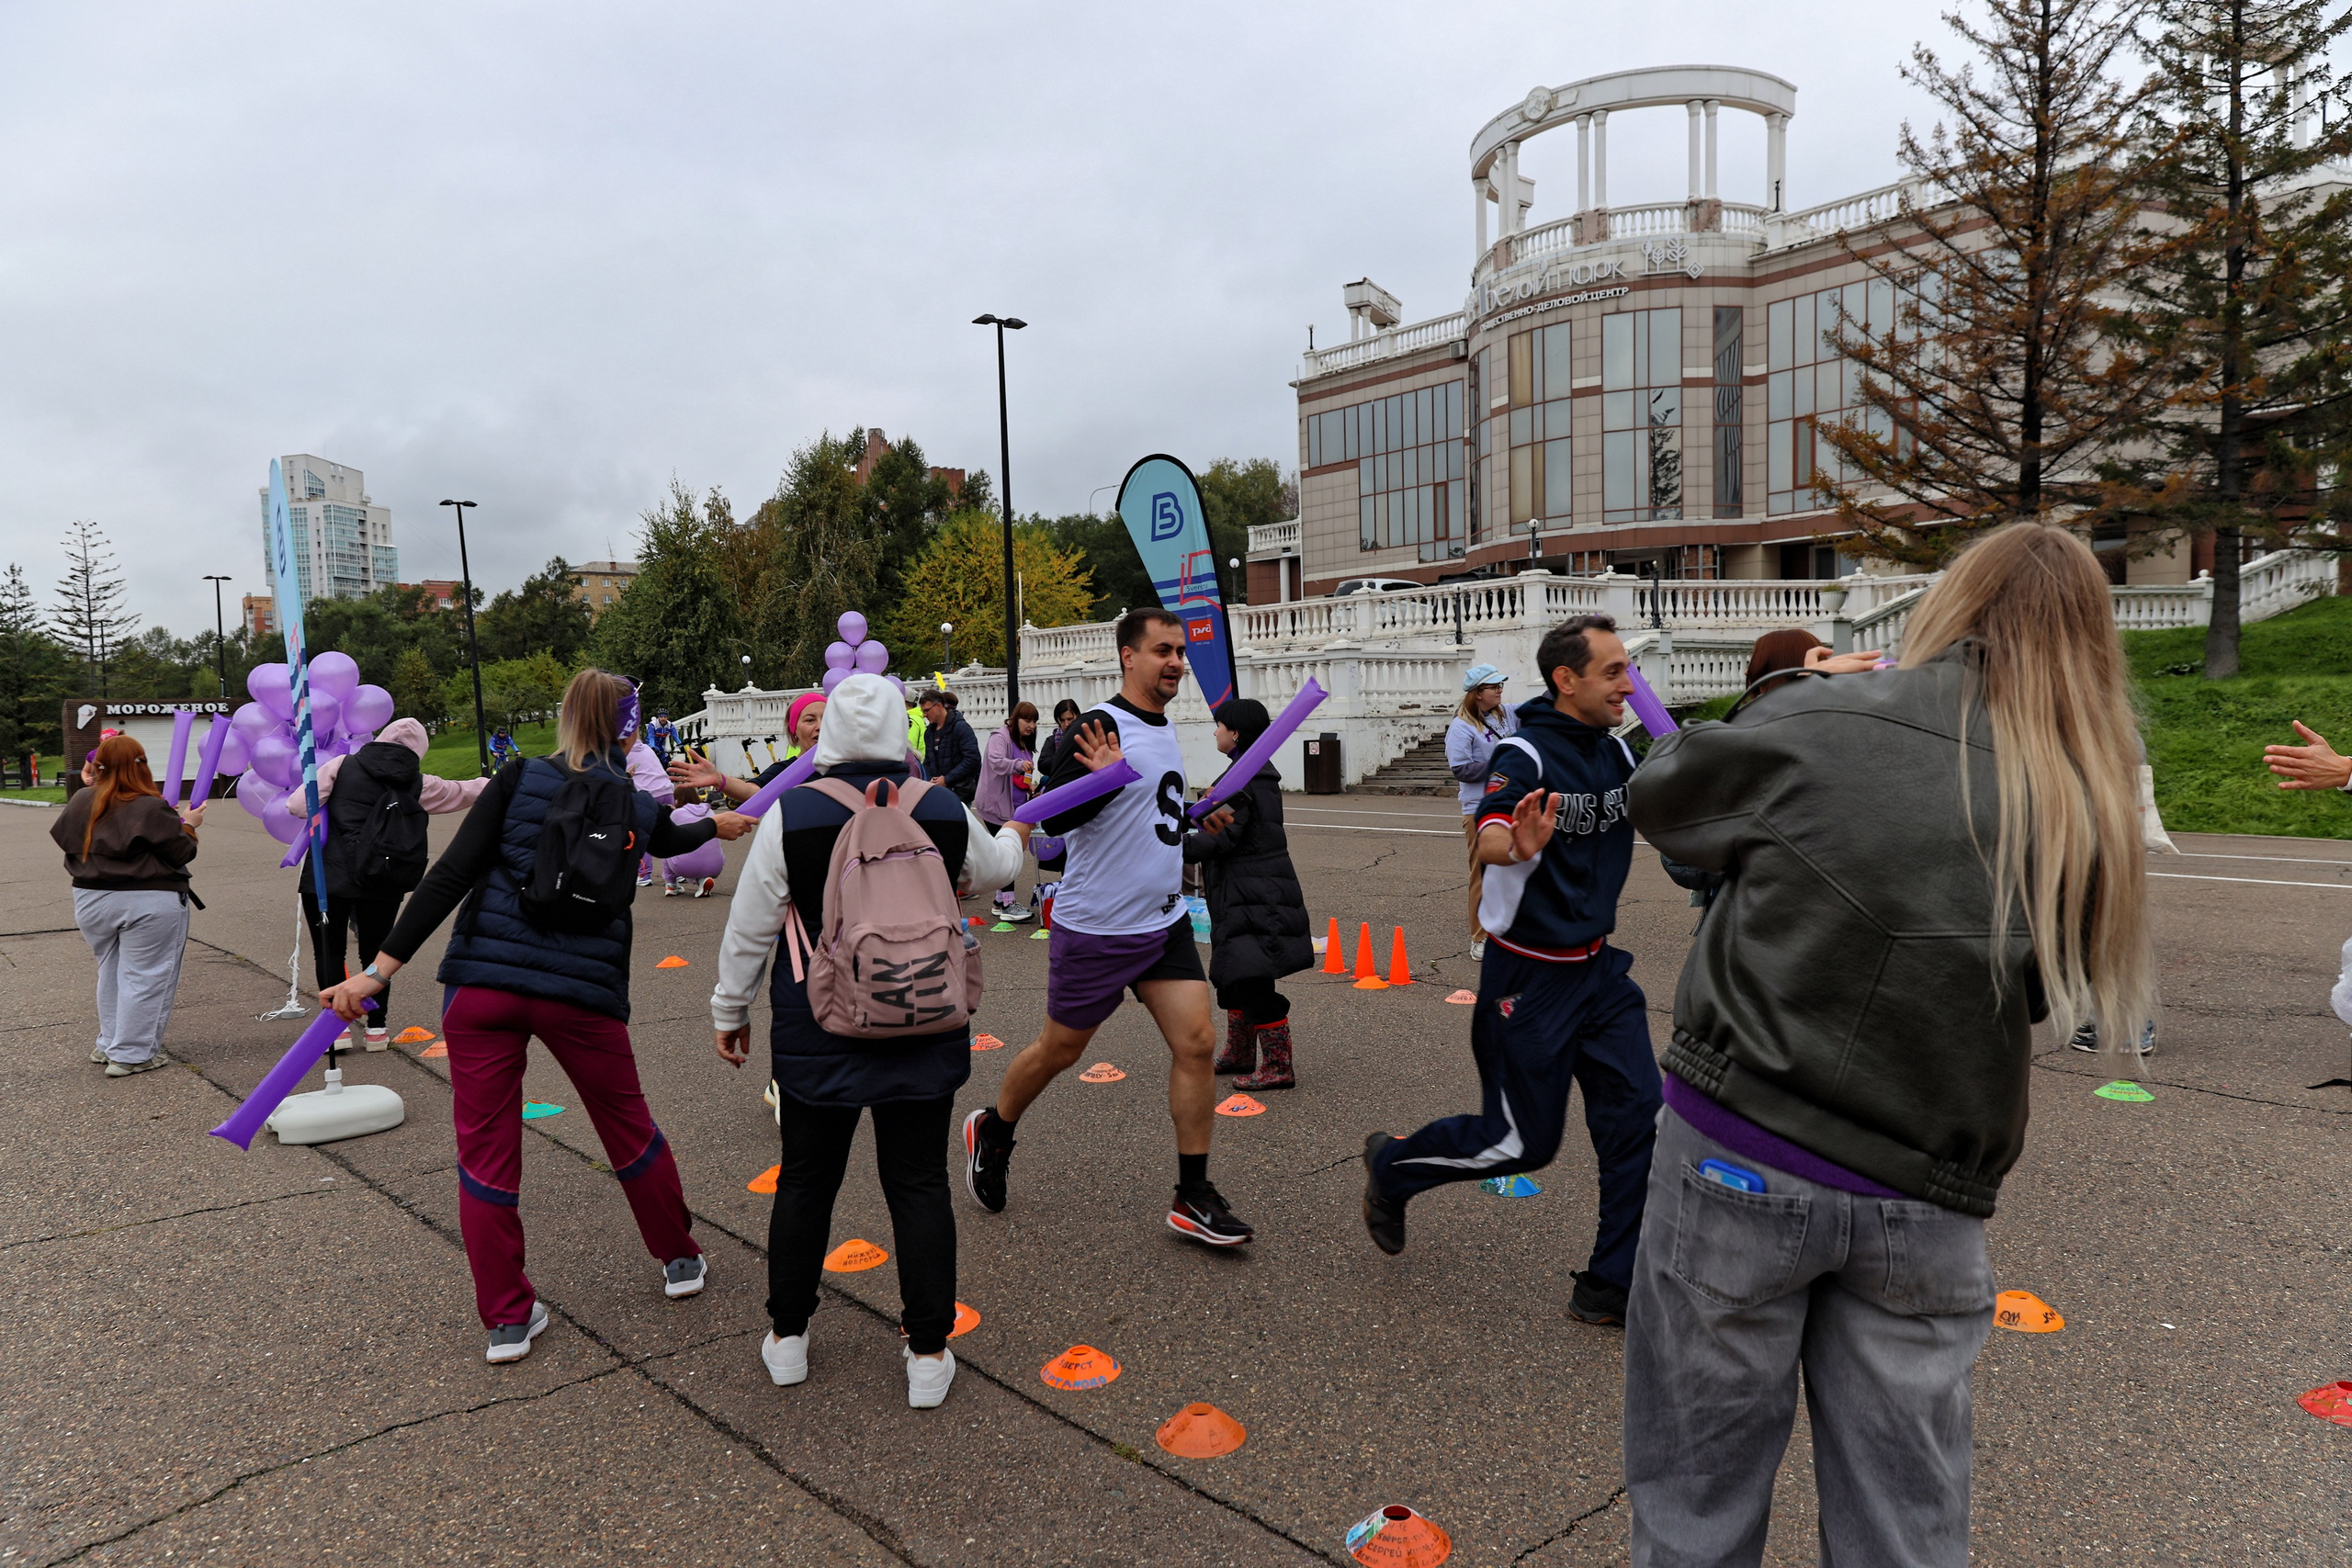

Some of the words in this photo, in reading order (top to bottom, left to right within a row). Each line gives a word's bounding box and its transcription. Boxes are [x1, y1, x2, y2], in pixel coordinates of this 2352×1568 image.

[1589, 286, 1629, 301] ЦЕНТР
[106, 702, 229, 716] МОРОЖЕНОЕ
[869, 957, 915, 1028] LAN
